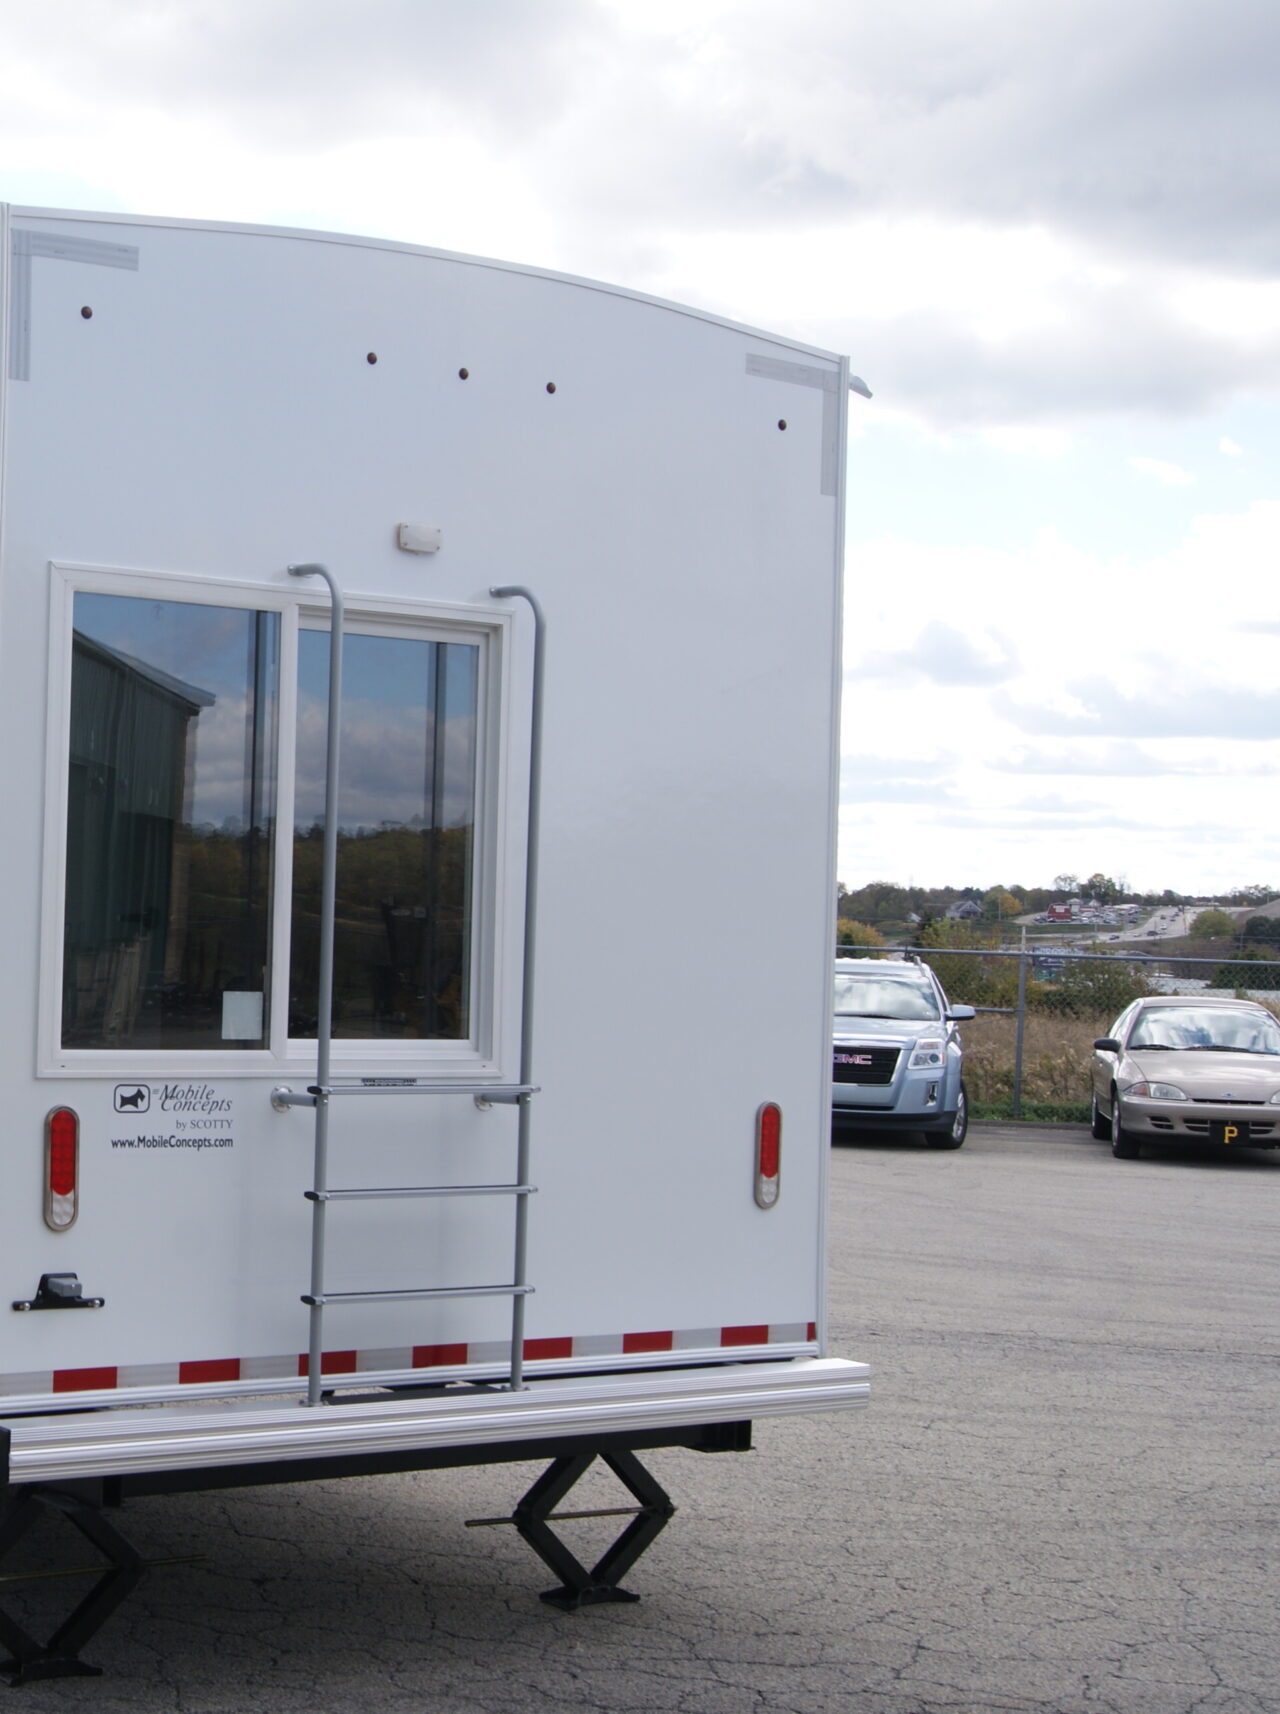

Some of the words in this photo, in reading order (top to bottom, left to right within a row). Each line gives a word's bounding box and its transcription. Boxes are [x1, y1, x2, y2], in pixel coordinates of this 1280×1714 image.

[159, 1084, 216, 1101] Mobile
[160, 1096, 233, 1115] Concepts
[176, 1119, 187, 1131] by
[189, 1119, 234, 1130] SCOTTY
[111, 1135, 234, 1152] www.MobileConcepts.com
[1224, 1126, 1238, 1144] P
